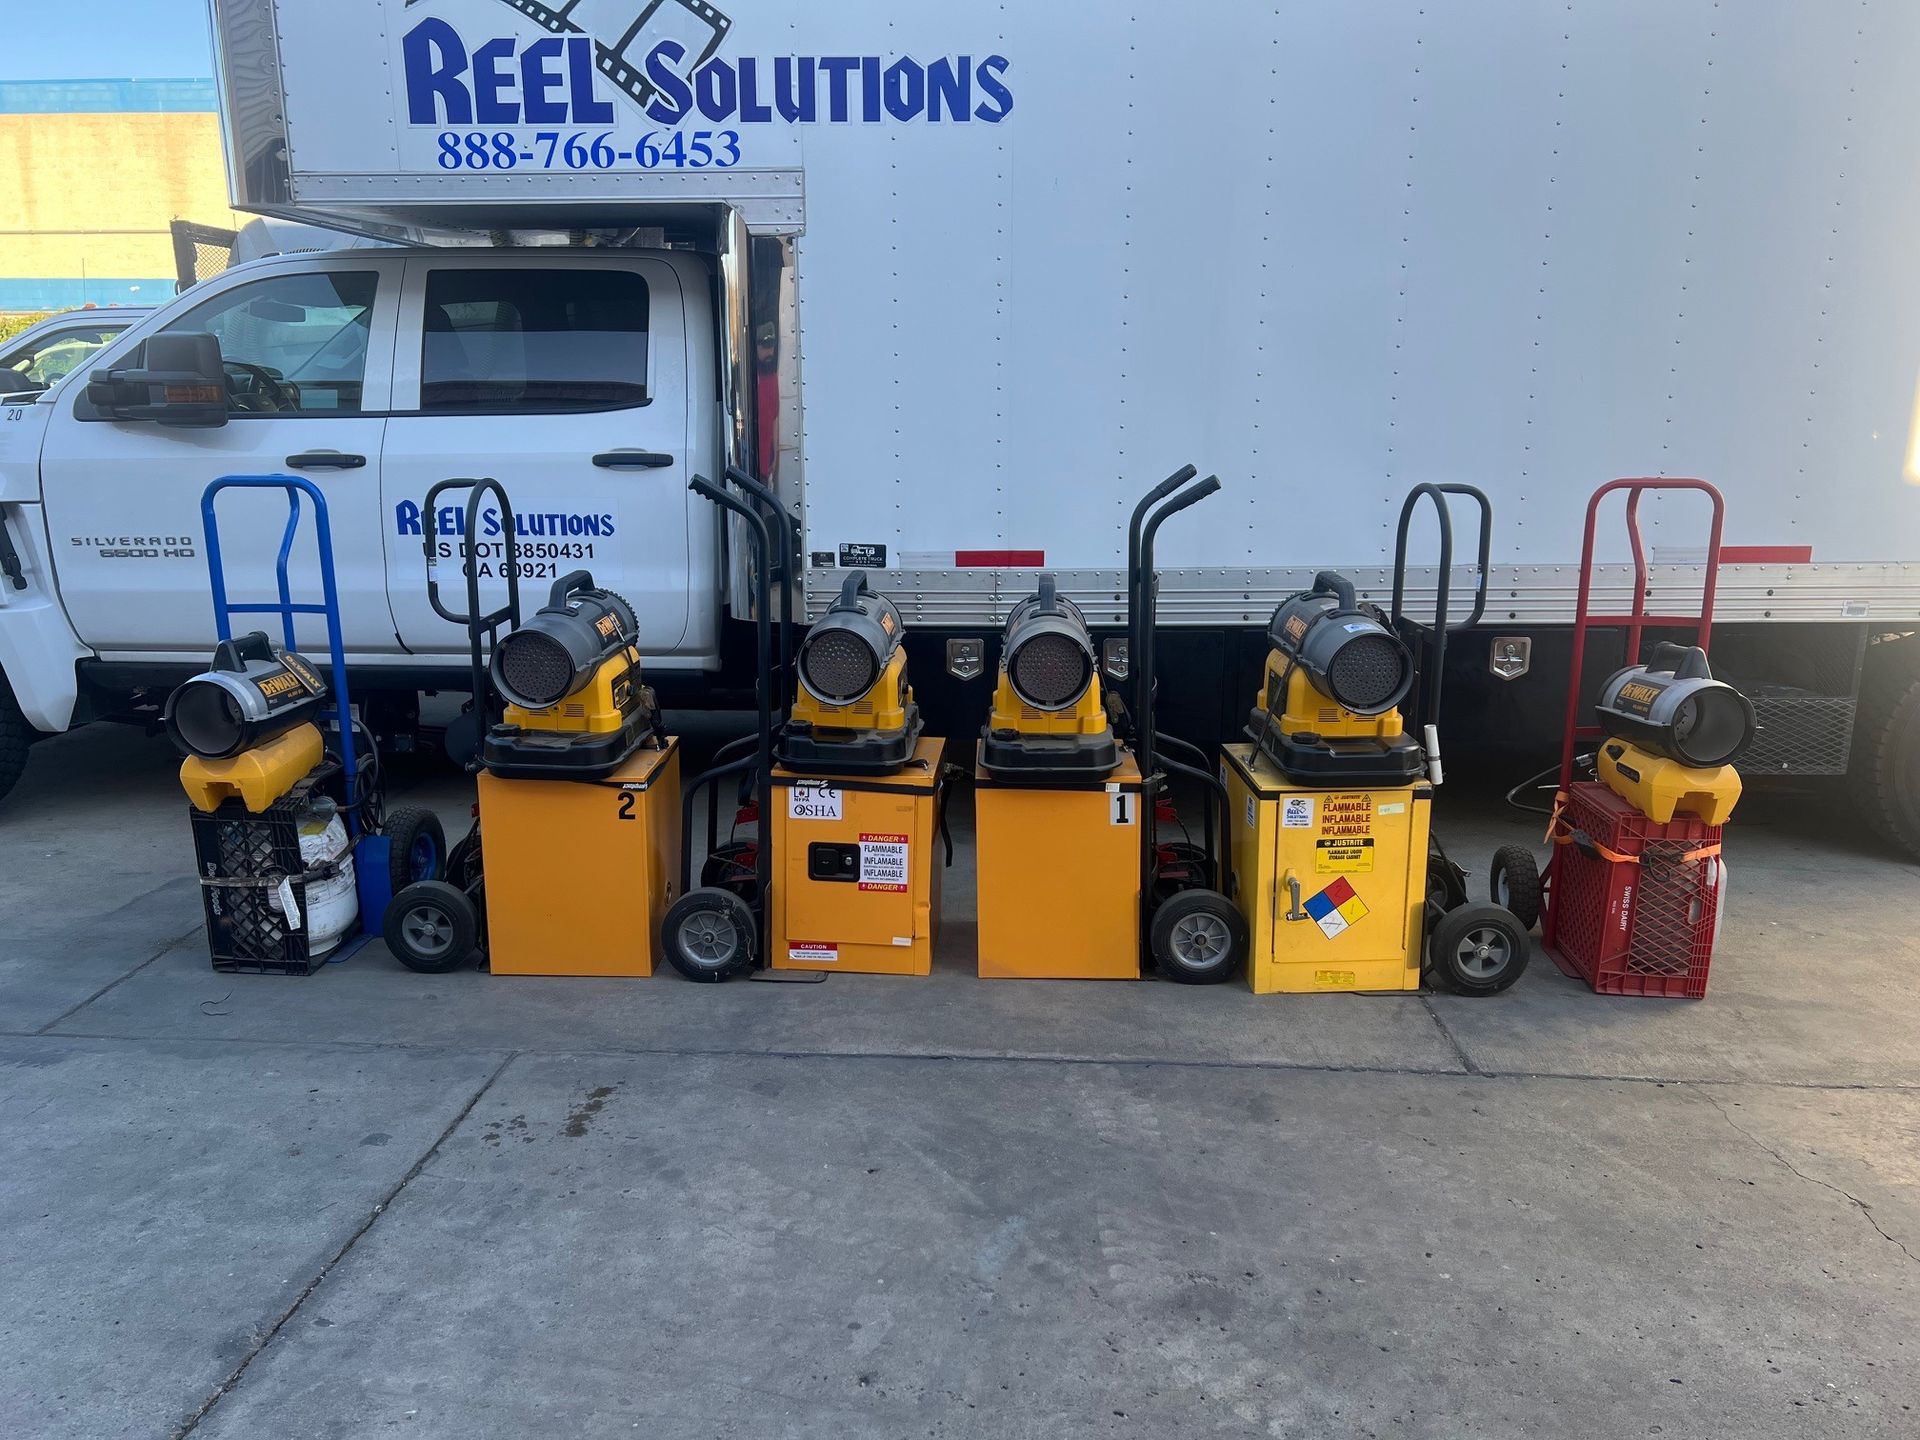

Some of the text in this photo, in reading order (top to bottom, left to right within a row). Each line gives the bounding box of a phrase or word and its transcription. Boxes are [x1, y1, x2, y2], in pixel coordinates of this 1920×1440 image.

[402, 16, 1015, 126] REEL SOLUTIONS
[437, 130, 741, 169] 888-766-6453
[482, 507, 616, 537] SLUTIONS
[71, 536, 192, 546] SILVERADO
[423, 542, 452, 558] S
[618, 791, 636, 820] 2
[793, 804, 837, 817] OSHA
[1116, 794, 1129, 824] 1
[1323, 802, 1372, 812] FLAMMABLE
[1322, 814, 1371, 824] INFLAMABLE
[867, 835, 900, 843] DANGER
[1332, 839, 1364, 847] JUSTRITE
[864, 844, 903, 854] FLAMMABLE
[863, 856, 904, 866] INFLAMABLE
[863, 868, 903, 878] INFLAMABLE
[866, 883, 899, 891] DANGER
[1622, 885, 1632, 909] SWISS
